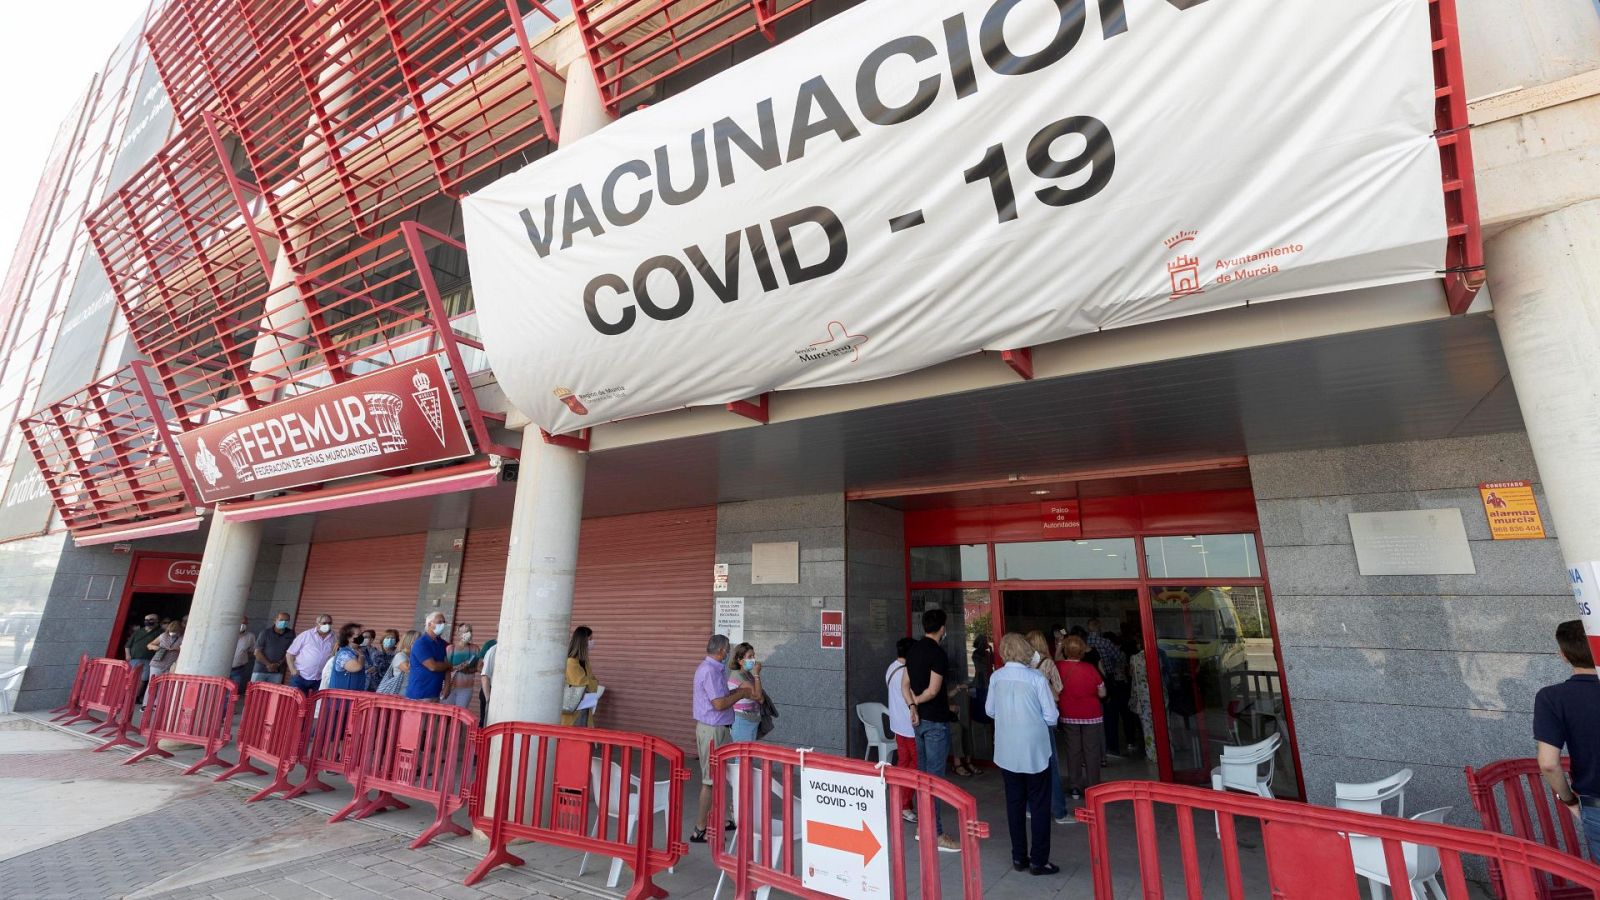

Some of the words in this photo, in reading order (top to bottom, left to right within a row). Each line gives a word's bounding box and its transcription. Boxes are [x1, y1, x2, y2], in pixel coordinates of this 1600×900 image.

[519, 0, 1210, 258] VACUNACIO
[583, 205, 849, 335] COVID
[889, 208, 926, 234] -
[964, 115, 1116, 223] 19
[1215, 243, 1304, 270] Ayuntamiento
[1216, 274, 1232, 284] de
[1234, 264, 1280, 281] Murcia
[798, 344, 851, 362] Murciano
[237, 396, 374, 462] FEPEMUR
[291, 458, 303, 469] DE
[302, 451, 325, 466] PEÑAS
[325, 441, 378, 463] MURCIANISTAS
[1494, 515, 1535, 524] murcia
[809, 781, 874, 799] VACUNACIÓN
[816, 795, 846, 808] COVID
[856, 802, 867, 812] 19
